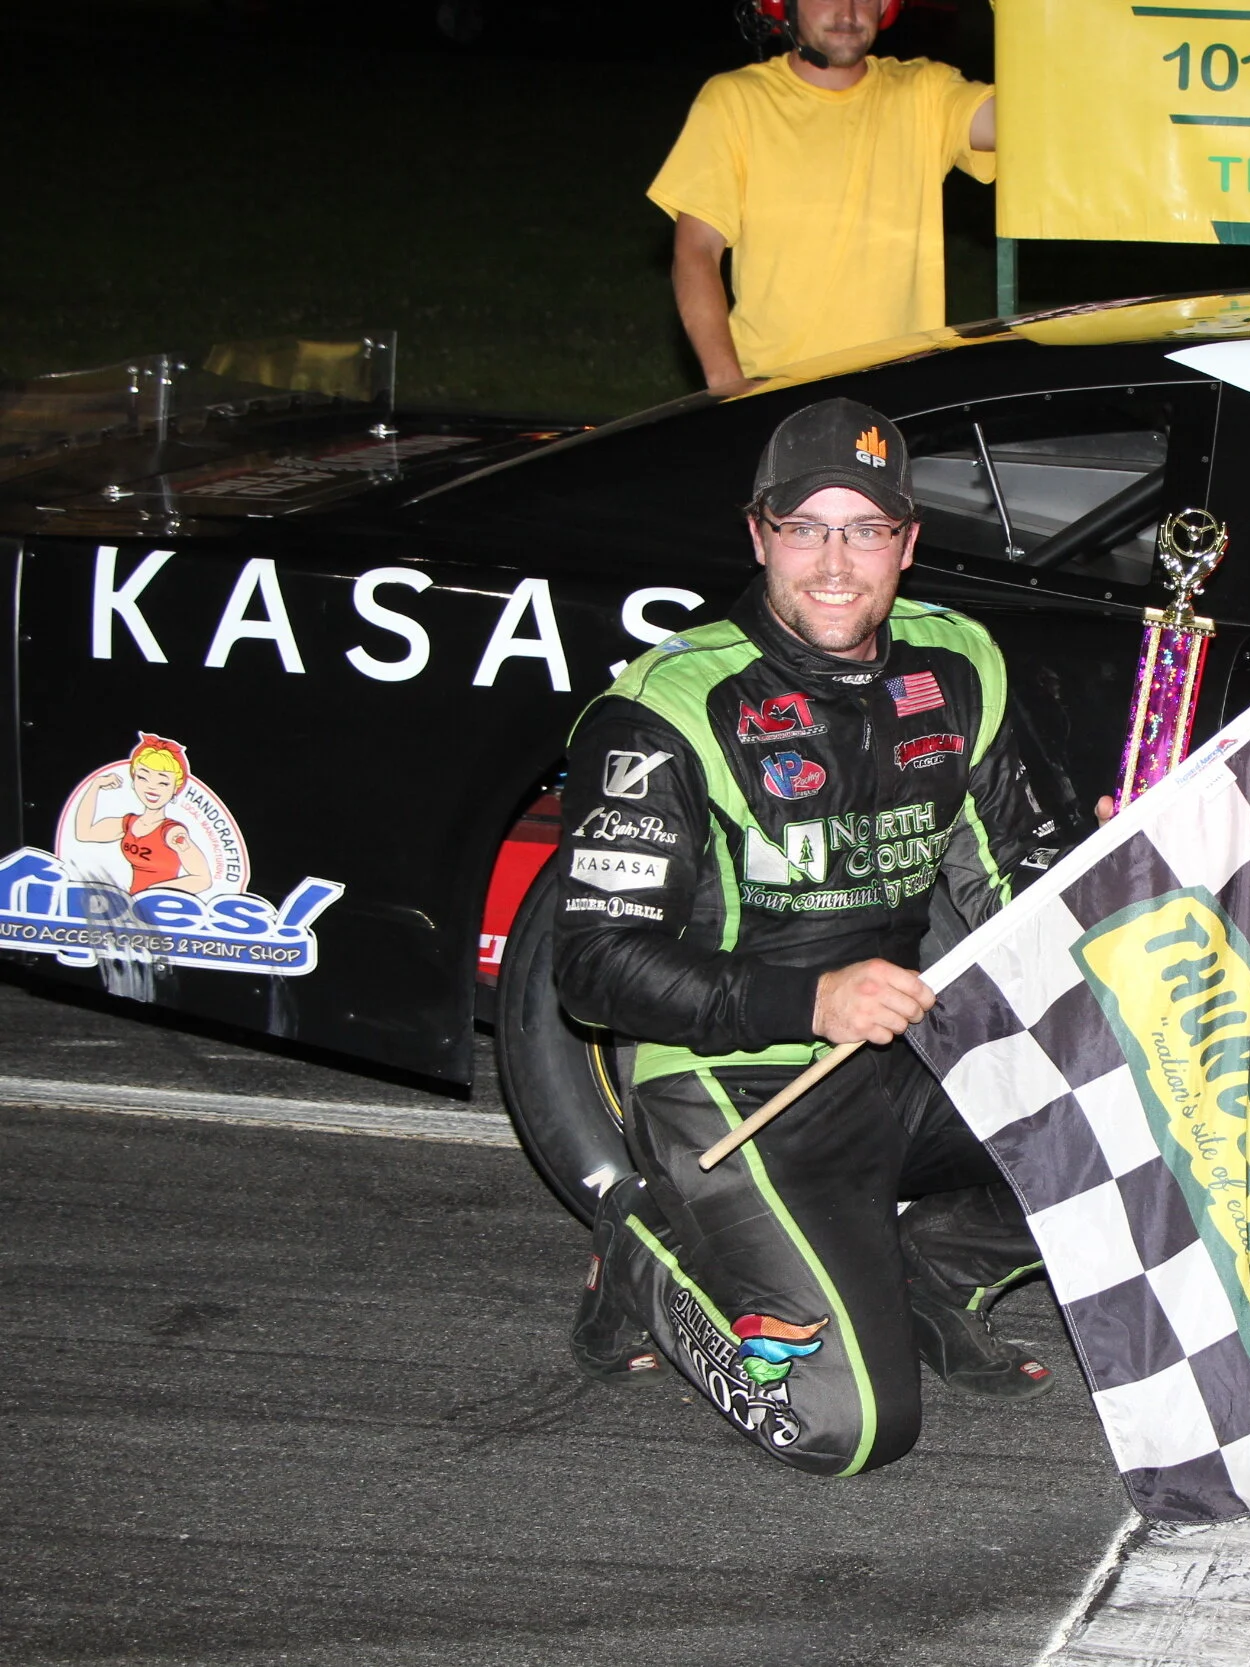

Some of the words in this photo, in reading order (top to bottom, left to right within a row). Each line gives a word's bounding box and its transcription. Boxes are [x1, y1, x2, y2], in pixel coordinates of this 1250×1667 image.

[914, 755, 944, 768] RACER
[185, 786, 240, 883] HANDCRAFTED
[640, 816, 679, 844] Press
[829, 803, 935, 848] NORTH
[577, 856, 656, 877] KASASA
[743, 885, 790, 911] Your
[625, 903, 664, 921] GRILL
[0, 924, 37, 940] UTO
[178, 939, 188, 953] &
[249, 945, 301, 963] SHOP
